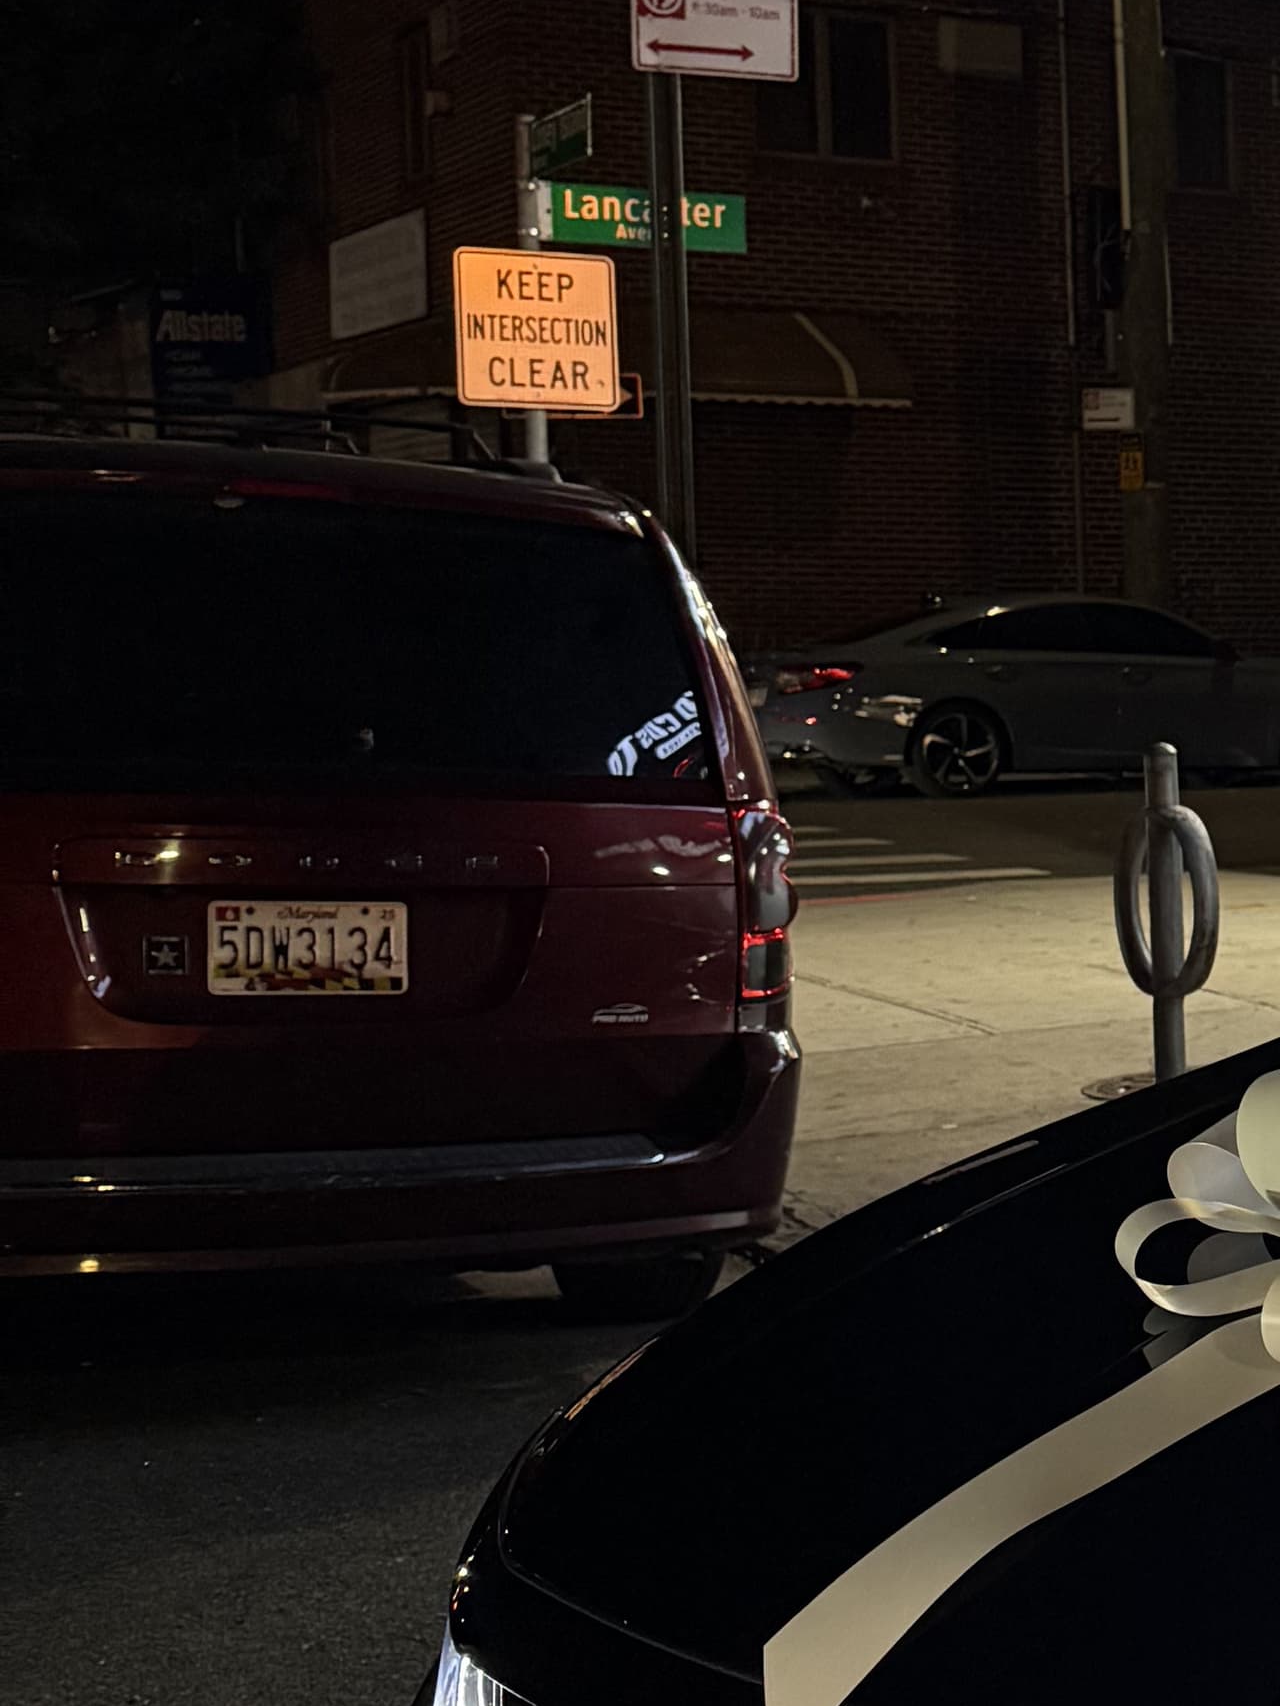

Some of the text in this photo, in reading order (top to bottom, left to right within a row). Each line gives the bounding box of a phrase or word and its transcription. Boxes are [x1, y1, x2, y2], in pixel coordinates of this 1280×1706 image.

[563, 188, 727, 228] Lancter
[496, 269, 575, 303] KEEP
[466, 313, 608, 347] INTERSECTION
[488, 356, 590, 390] CLEAR
[277, 905, 339, 923] Maryland
[218, 925, 393, 973] 5DW3134
